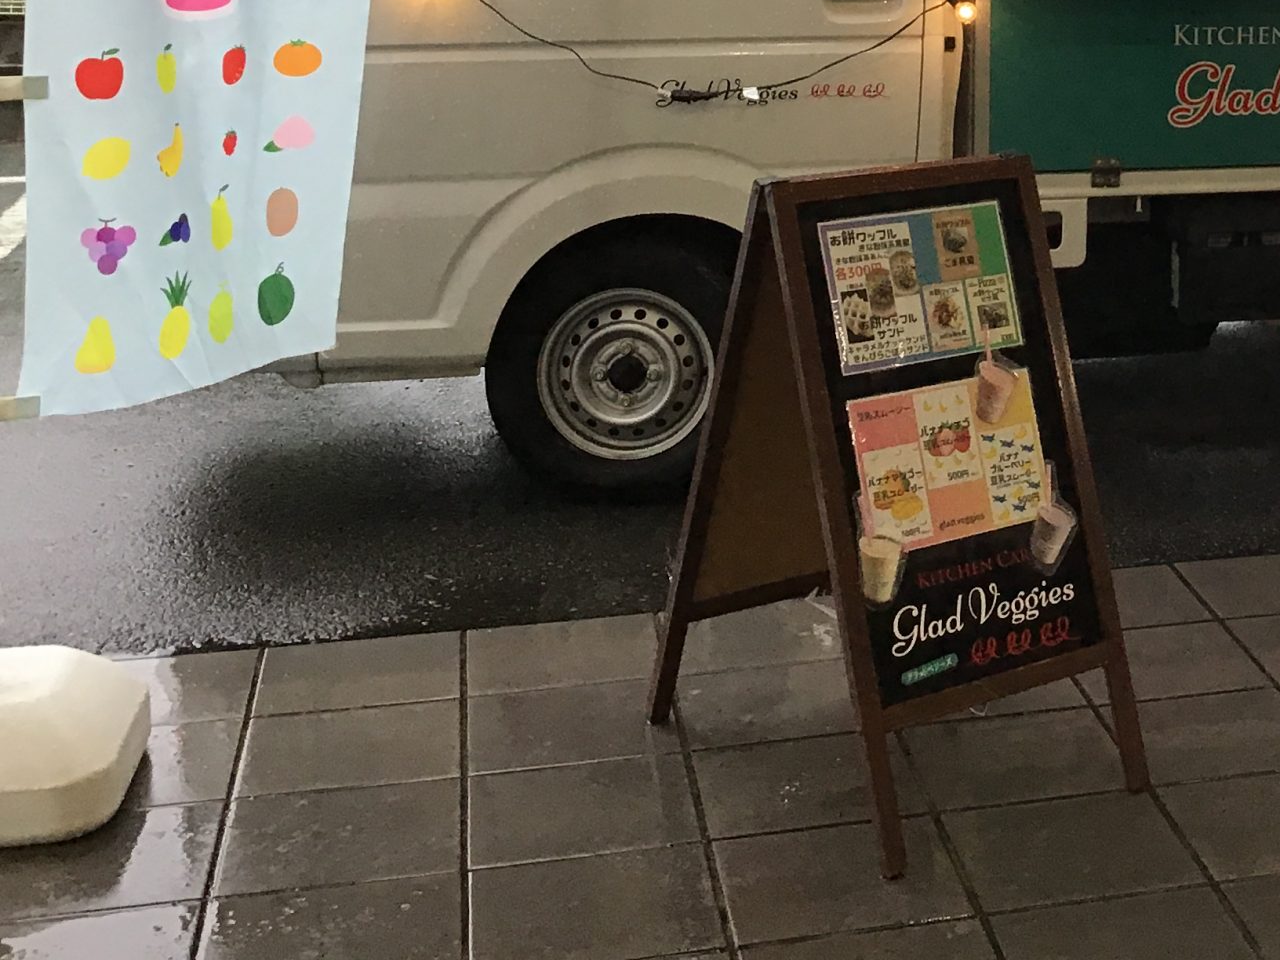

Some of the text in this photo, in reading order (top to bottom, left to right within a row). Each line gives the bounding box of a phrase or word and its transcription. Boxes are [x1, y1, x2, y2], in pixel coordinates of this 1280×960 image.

[829, 228, 898, 248] お餅ワッフル
[877, 326, 905, 339] サンド
[916, 548, 1031, 589] KITCHEN CAR
[892, 580, 1075, 657] Glad Veggies
